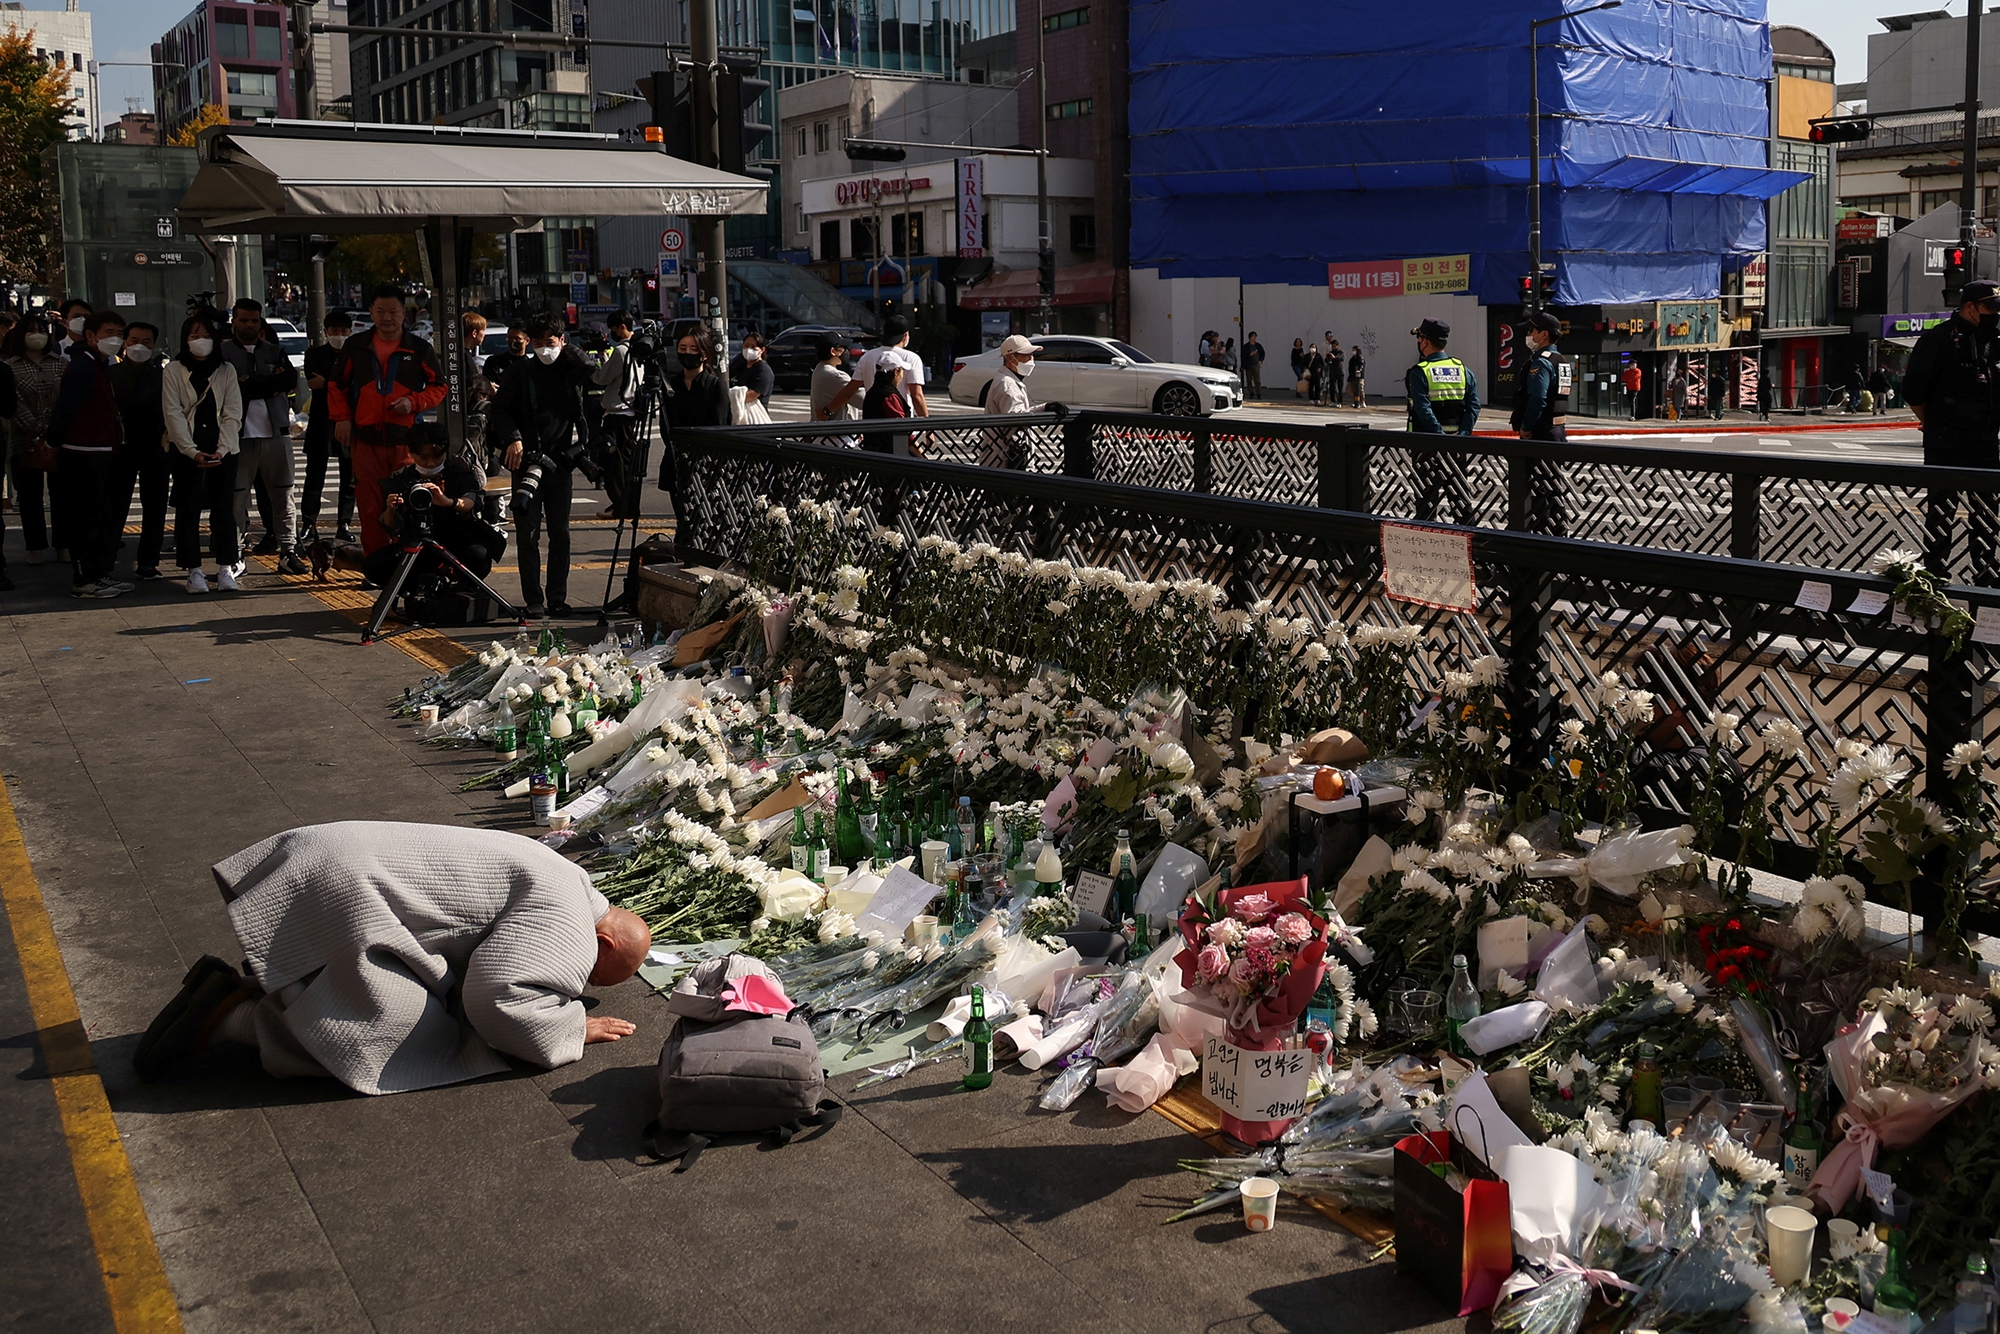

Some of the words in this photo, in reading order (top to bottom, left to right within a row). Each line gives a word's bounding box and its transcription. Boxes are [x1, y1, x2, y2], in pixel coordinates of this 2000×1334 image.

[690, 195, 731, 211] 용산구
[835, 177, 882, 206] OPUS
[963, 163, 977, 247] TRANS
[666, 234, 680, 247] 50
[1841, 223, 1858, 231] Sultan
[1332, 273, 1361, 290] 임대
[1365, 271, 1400, 288] (1층)
[1406, 279, 1467, 292] 010-3129-6083
[1841, 267, 1851, 302] BEDLAM
[446, 287, 456, 315] 세계의
[447, 321, 456, 339] 중심
[1910, 318, 1923, 332] CU
[447, 342, 458, 371] 이제는
[1497, 373, 1515, 382] CAFE
[449, 375, 460, 413] 용산시대
[1207, 1038, 1240, 1076] 고인의
[1254, 1053, 1305, 1078] 명복을
[1208, 1071, 1240, 1109] 빕니다.
[1793, 1153, 1812, 1181] 참이슬
